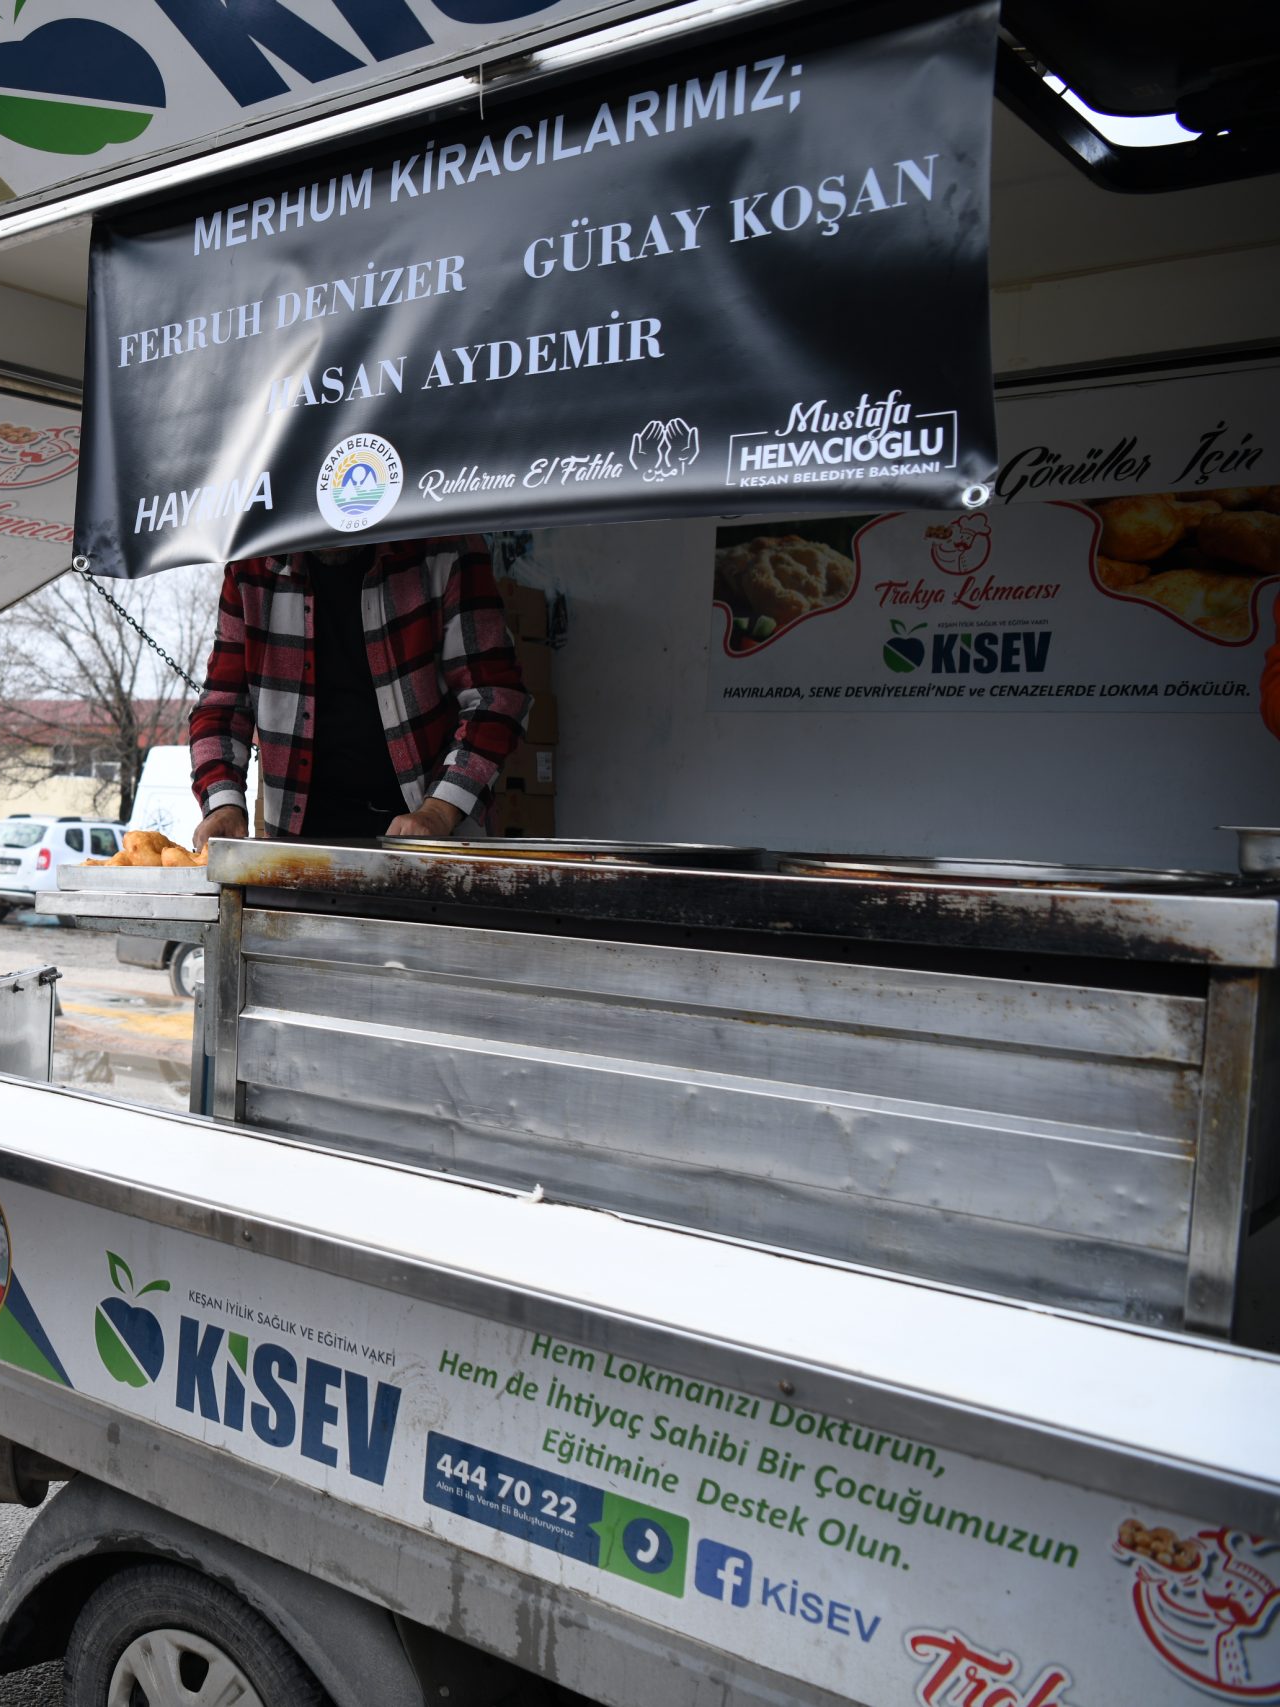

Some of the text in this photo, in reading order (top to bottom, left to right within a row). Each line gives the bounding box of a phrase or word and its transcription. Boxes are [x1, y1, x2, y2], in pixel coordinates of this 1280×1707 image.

[193, 55, 804, 256] MERHUM KİRACILARIMIZ;
[117, 153, 939, 368] FERRUH DENİZER GÜRAY KOŞAN
[265, 310, 664, 416] HASAN AYDEMİR
[775, 389, 912, 440] Mustafa
[320, 437, 400, 491] KEŞAN BELEDİYESİ
[418, 451, 624, 502] Ruhlarına El Fatiha
[740, 473, 789, 488] KEŞAN
[869, 461, 941, 477] BAŞKANI
[993, 420, 1264, 504] Gönüller İçin
[339, 517, 368, 530] 1866
[874, 575, 1062, 610] Trakya Lokmacısı
[931, 631, 1052, 674] KİSEV
[723, 686, 805, 700] HAYIRLARDA,
[808, 686, 841, 698] SENE
[969, 687, 985, 697] ve
[989, 684, 1095, 697] CENAZELERDE
[1099, 684, 1159, 697] LOKMA
[1163, 680, 1251, 697] DÖKÜLÜR.
[188, 1289, 223, 1311] KEŞAN
[225, 1298, 255, 1322] İYİLİK
[257, 1312, 297, 1336] SAĞLIK
[300, 1324, 314, 1341] VE
[317, 1329, 358, 1355] EĞİTİM
[176, 1315, 402, 1487] KİSEV
[530, 1333, 596, 1373] Hem
[603, 1353, 761, 1420] Lokmanızı
[436, 1453, 578, 1525] 444 70 22
[438, 1349, 1079, 1569] Hem de İhtiyaç Sahibi Bir Çocuğumuzun
[436, 1480, 575, 1538] Alan El ile Veren Eli Buluşturuyoruz
[542, 1428, 911, 1571] Eğitimine Destek Olun.
[761, 1576, 882, 1644] KİSEV
